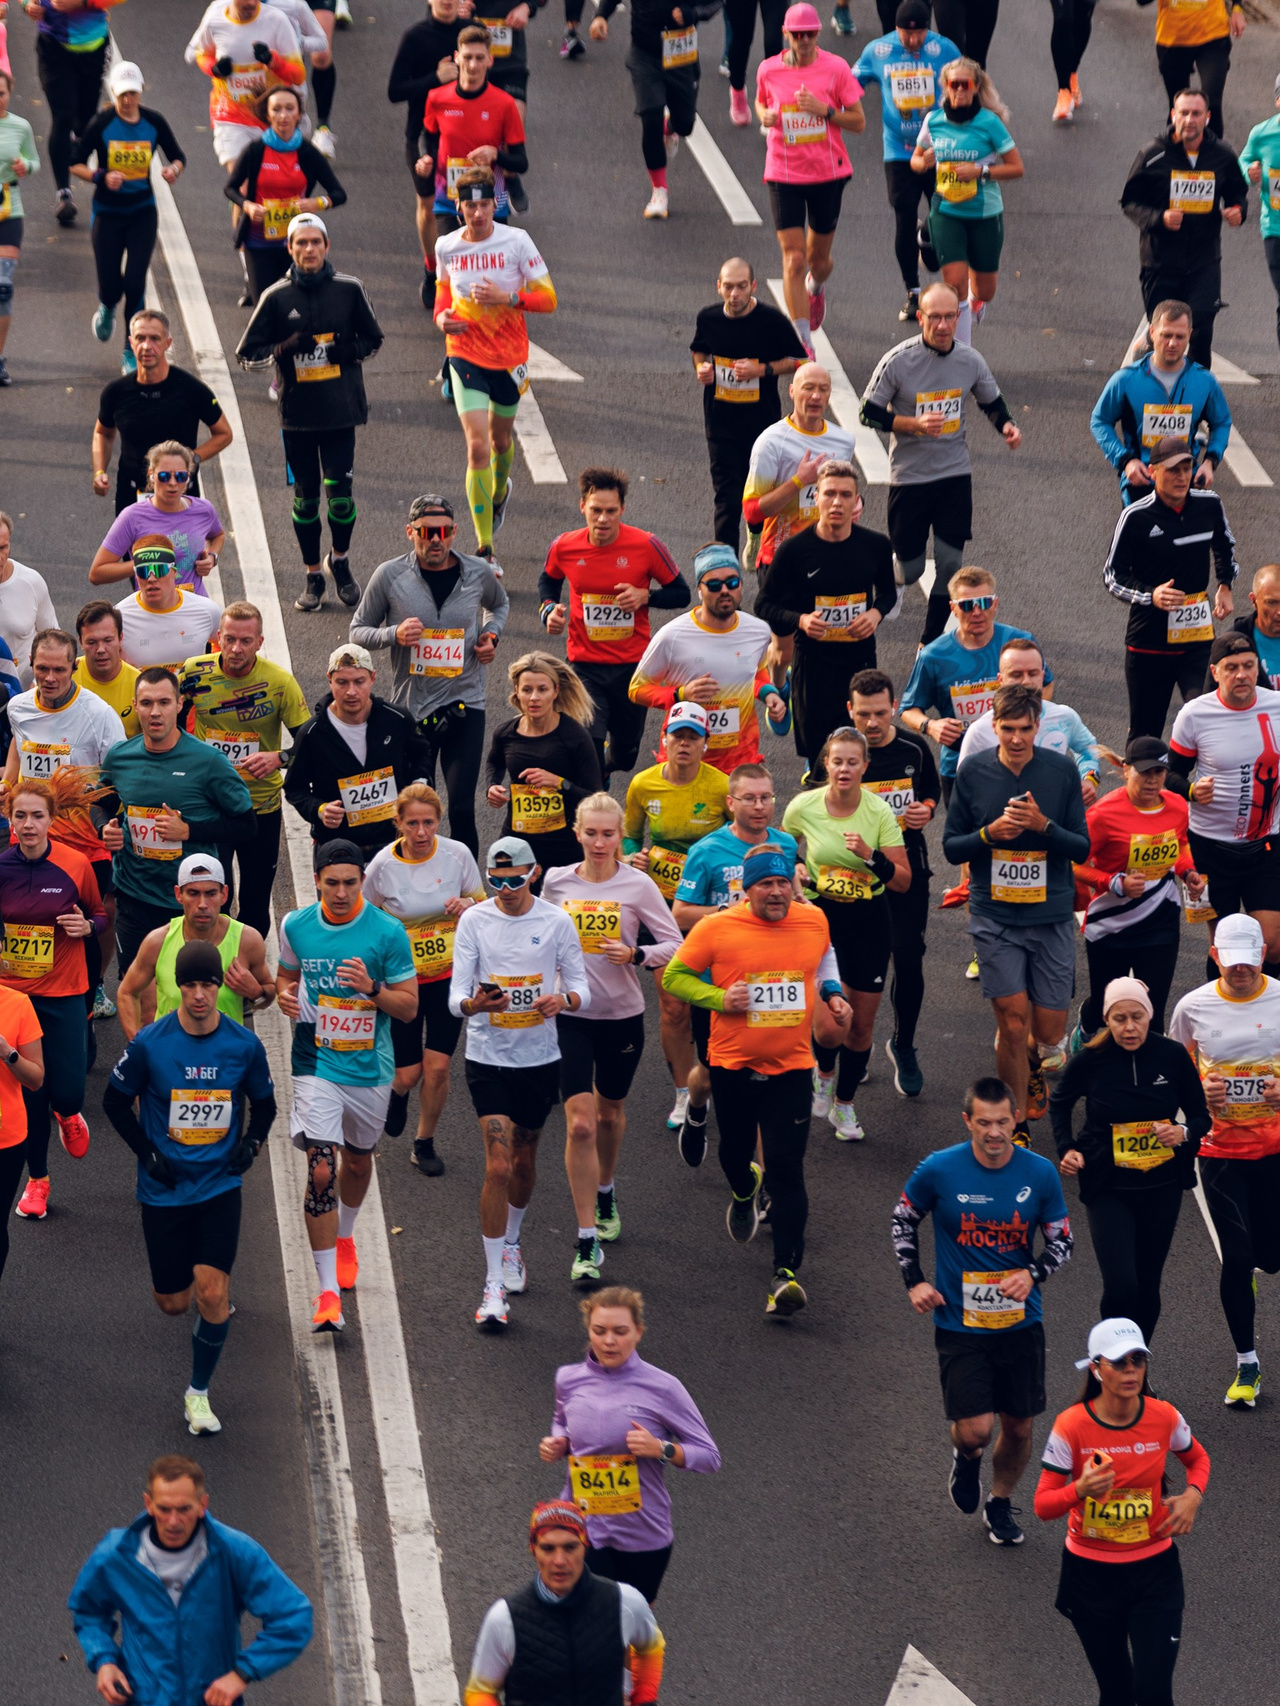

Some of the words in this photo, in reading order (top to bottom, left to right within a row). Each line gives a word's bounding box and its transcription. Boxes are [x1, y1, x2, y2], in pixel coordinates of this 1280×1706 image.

[897, 76, 927, 88] 5851
[784, 119, 822, 130] 18648
[115, 151, 145, 163] 8933
[1174, 182, 1213, 194] 17092
[1150, 416, 1185, 430] 7408
[585, 605, 632, 621] 12928
[823, 605, 861, 621] 7315
[1175, 605, 1206, 622] 2336
[415, 645, 461, 659] 18414
[27, 754, 60, 772] 1211
[350, 781, 388, 803] 2467
[360, 800, 384, 809] ДМИТРИЙ
[516, 796, 560, 813] 13593
[1134, 844, 1178, 863] 16892
[999, 867, 1041, 883] 4008
[826, 878, 865, 899] 2335
[576, 913, 617, 931] 1239
[2, 937, 52, 956] 12717
[415, 938, 446, 958] 588
[302, 959, 335, 972] БЕГУ
[754, 986, 797, 1003] 2118
[320, 1014, 373, 1033] 19475
[1225, 1079, 1263, 1096] 2578
[179, 1104, 224, 1121] 2997
[580, 1469, 631, 1490] 8414
[1089, 1502, 1149, 1520] 14103
